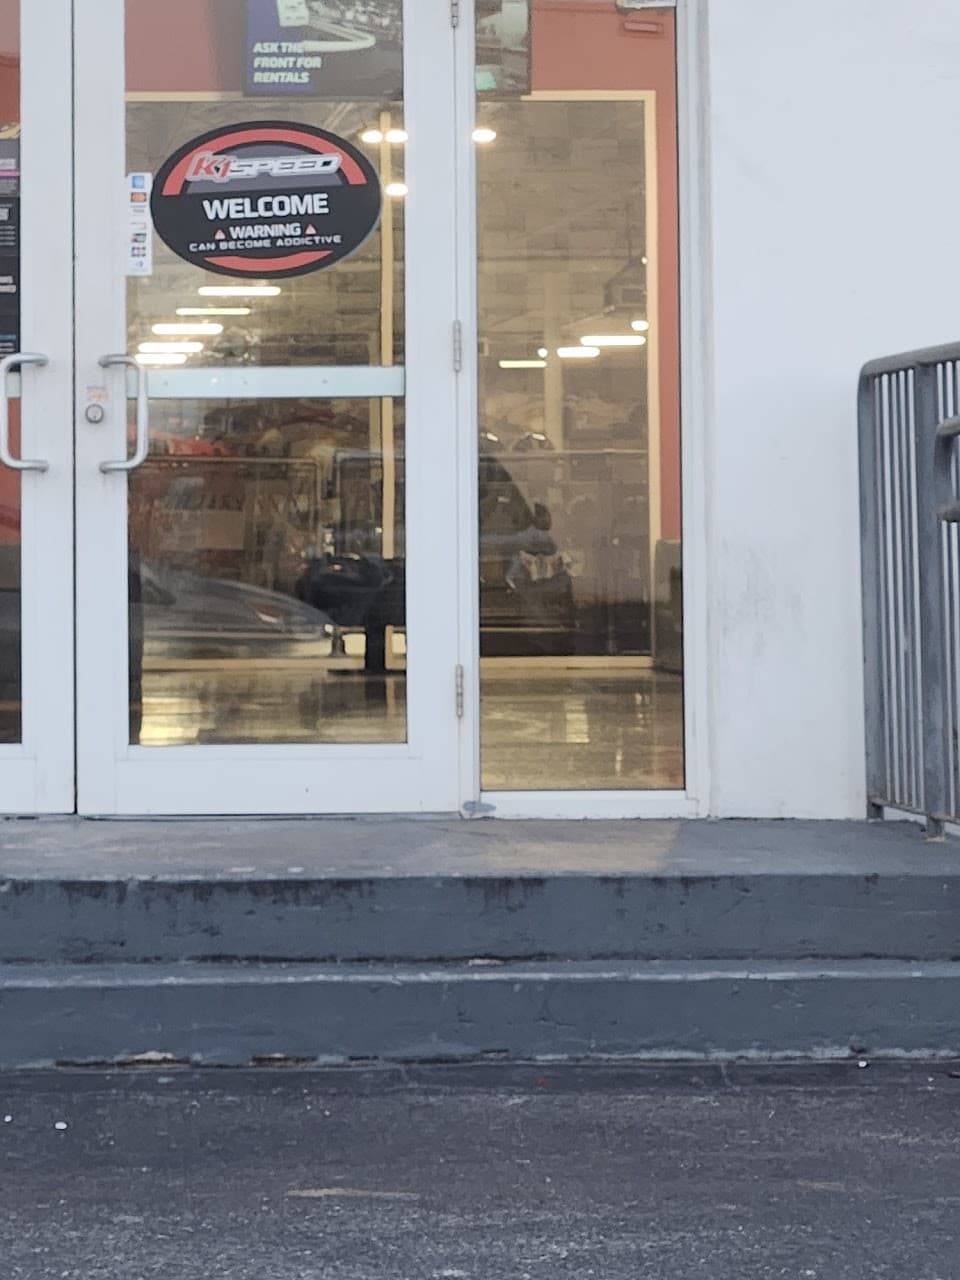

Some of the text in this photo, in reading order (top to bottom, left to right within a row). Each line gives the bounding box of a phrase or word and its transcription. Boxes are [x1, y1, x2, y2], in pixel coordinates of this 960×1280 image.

[253, 42, 279, 53] ASK
[253, 56, 322, 68] FRONT FOR
[253, 71, 310, 83] RENTALS
[202, 193, 329, 220] WELCOME
[229, 223, 301, 239] WARNING
[189, 234, 342, 252] CAN BECOME ADDICTIVE
